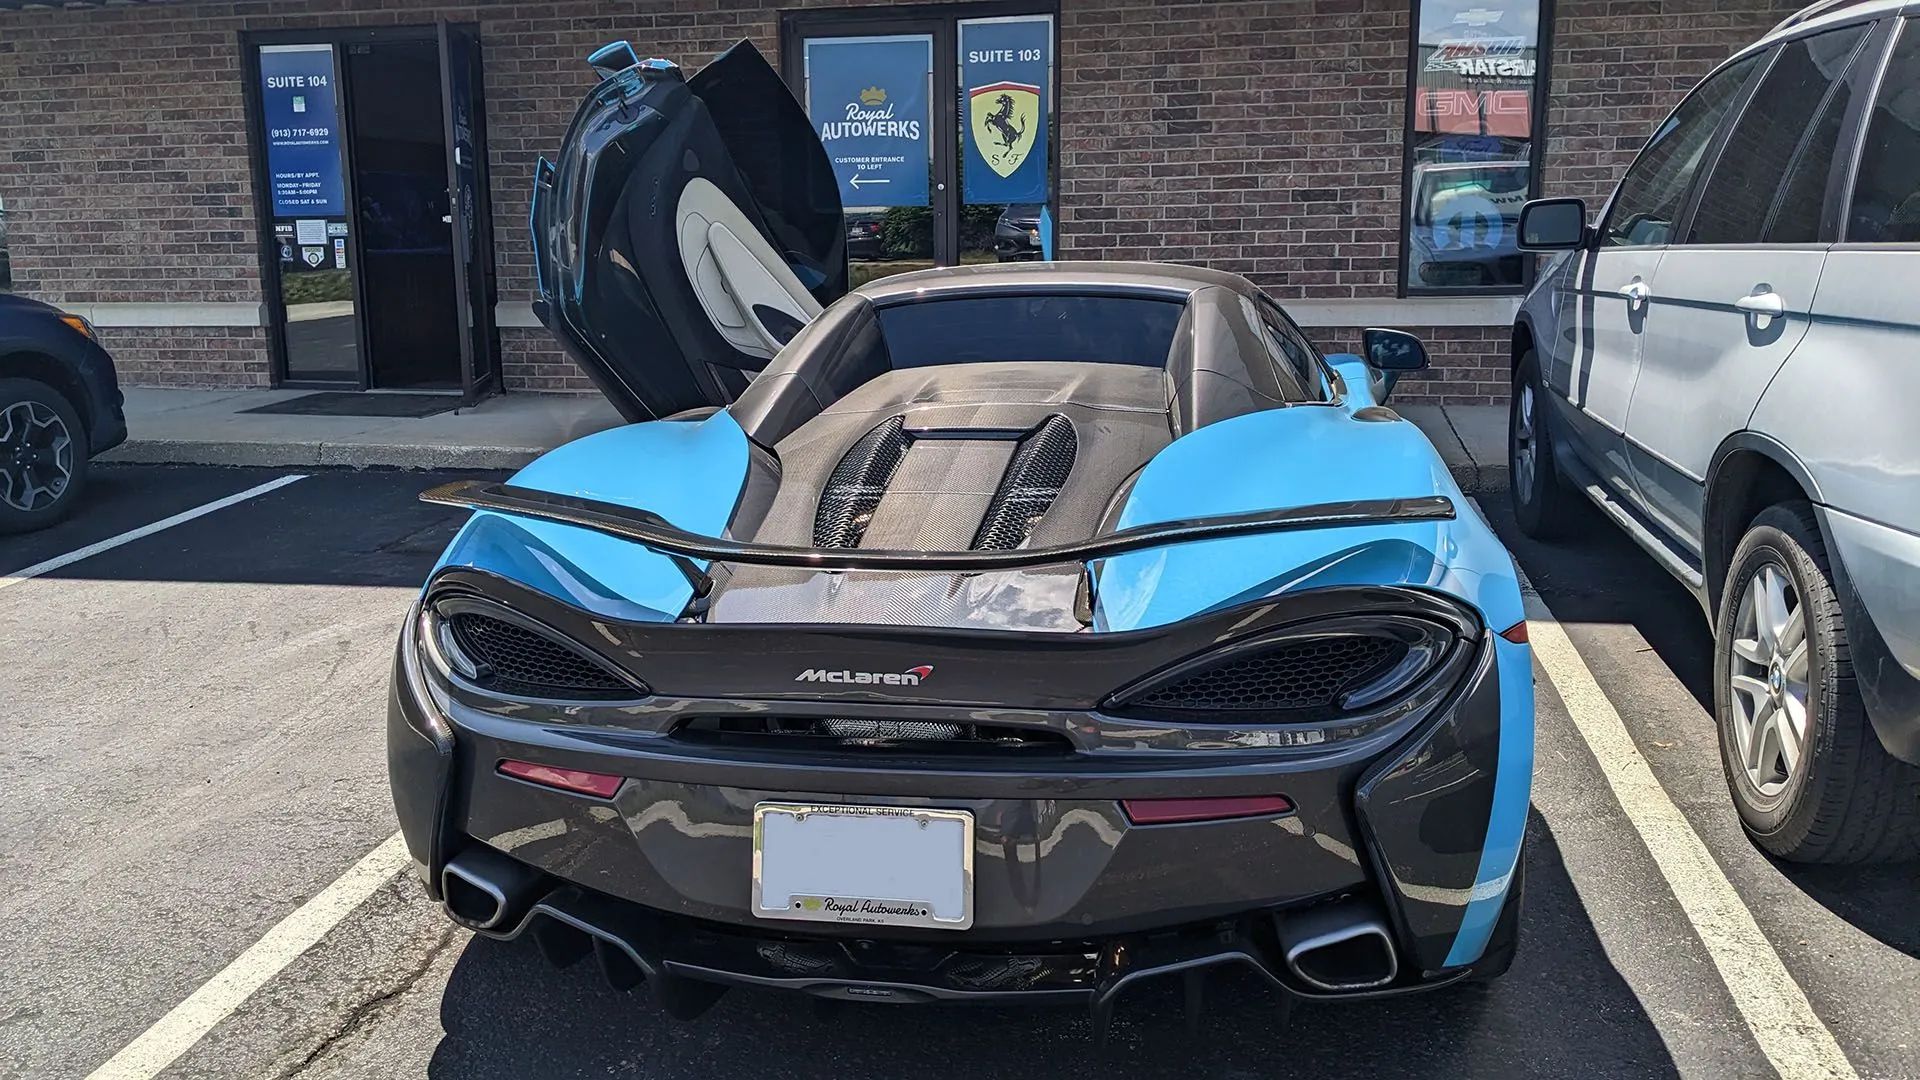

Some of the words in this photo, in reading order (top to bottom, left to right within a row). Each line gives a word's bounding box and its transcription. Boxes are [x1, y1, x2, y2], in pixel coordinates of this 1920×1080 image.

[969, 50, 1013, 63] SUITE
[1018, 49, 1041, 61] 103
[1427, 38, 1526, 61] AMSOIL
[267, 76, 305, 88] SUITE
[308, 75, 327, 87] 104
[1419, 90, 1528, 115] GMC
[845, 103, 894, 126] Royal
[271, 128, 291, 138] (913)
[292, 128, 329, 137] 717-6929
[821, 121, 920, 142] AUTOWERKS
[795, 669, 919, 686] McLaren
[810, 805, 874, 815] EXCEPTIONAL
[875, 807, 915, 817] SERVICE
[824, 897, 859, 917] Royal
[860, 900, 920, 917] Autowerks
